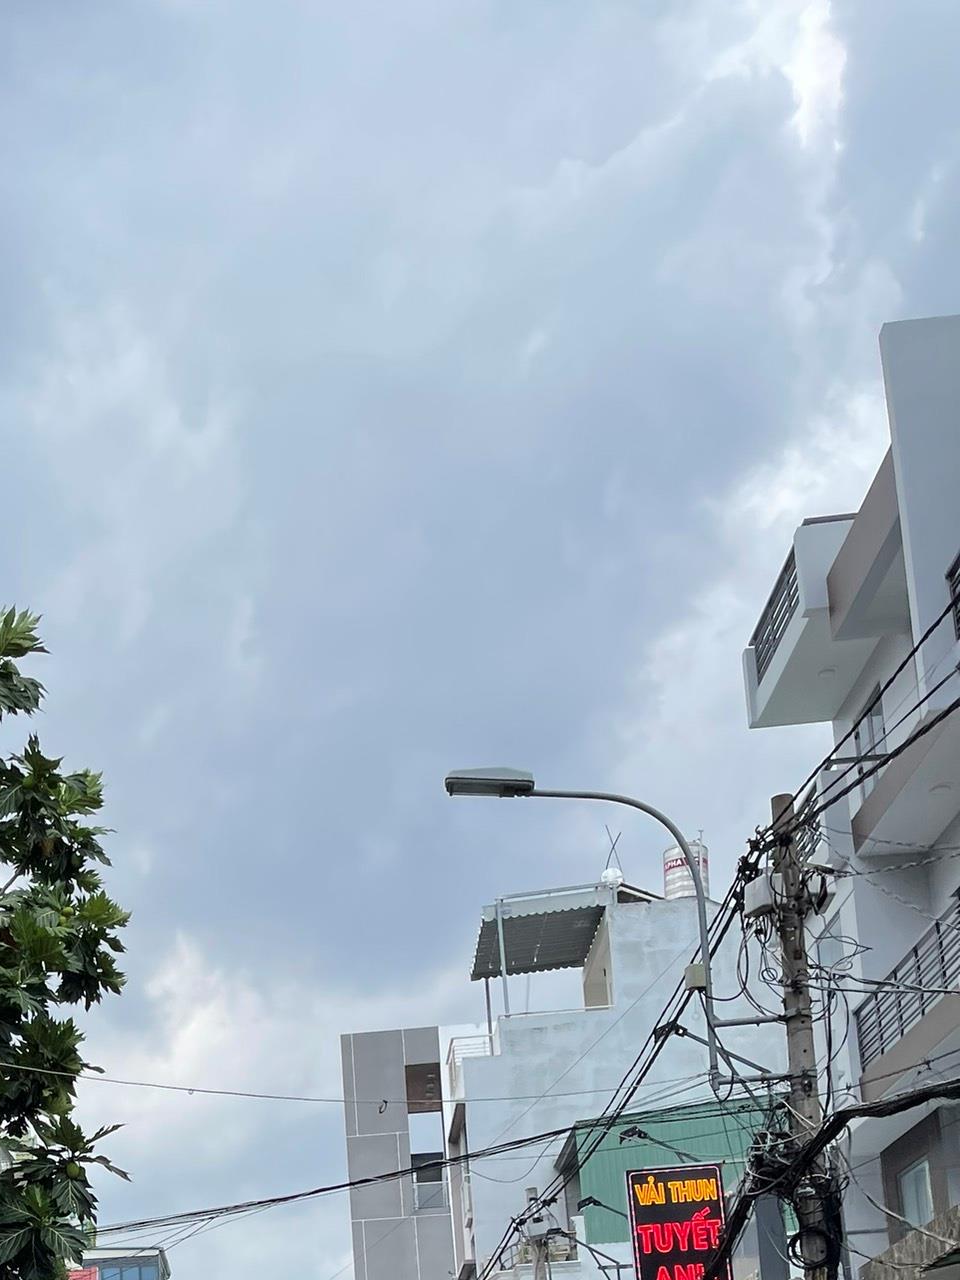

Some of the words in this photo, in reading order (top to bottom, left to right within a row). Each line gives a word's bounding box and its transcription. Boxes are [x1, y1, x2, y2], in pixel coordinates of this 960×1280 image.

[634, 1176, 666, 1205] VẢI
[668, 1178, 718, 1203] THUN
[637, 1207, 721, 1253] TUYẾT
